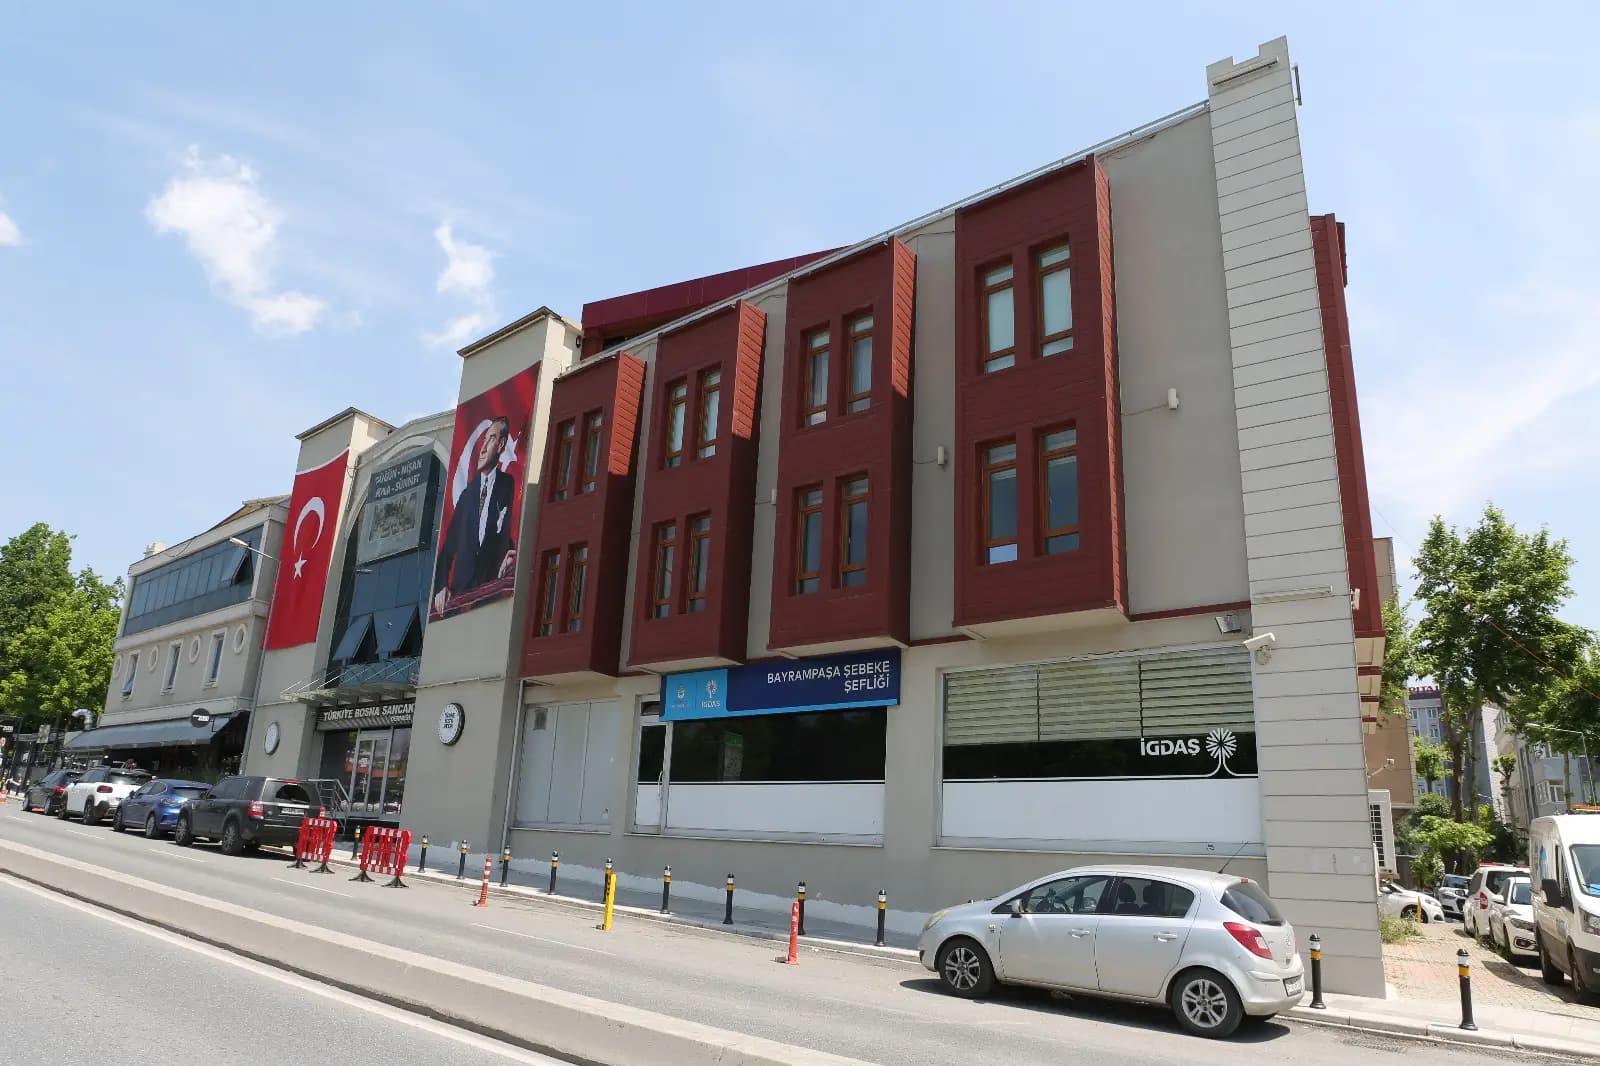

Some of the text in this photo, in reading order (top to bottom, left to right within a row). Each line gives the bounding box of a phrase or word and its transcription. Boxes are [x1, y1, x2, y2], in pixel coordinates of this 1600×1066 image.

[767, 660, 890, 684] BAYRAMPAŞA ŞEBEKE
[844, 674, 890, 693] ŞEFLİĞİ
[354, 706, 380, 718] BOSNA
[1140, 737, 1201, 756] İGDAŞ
